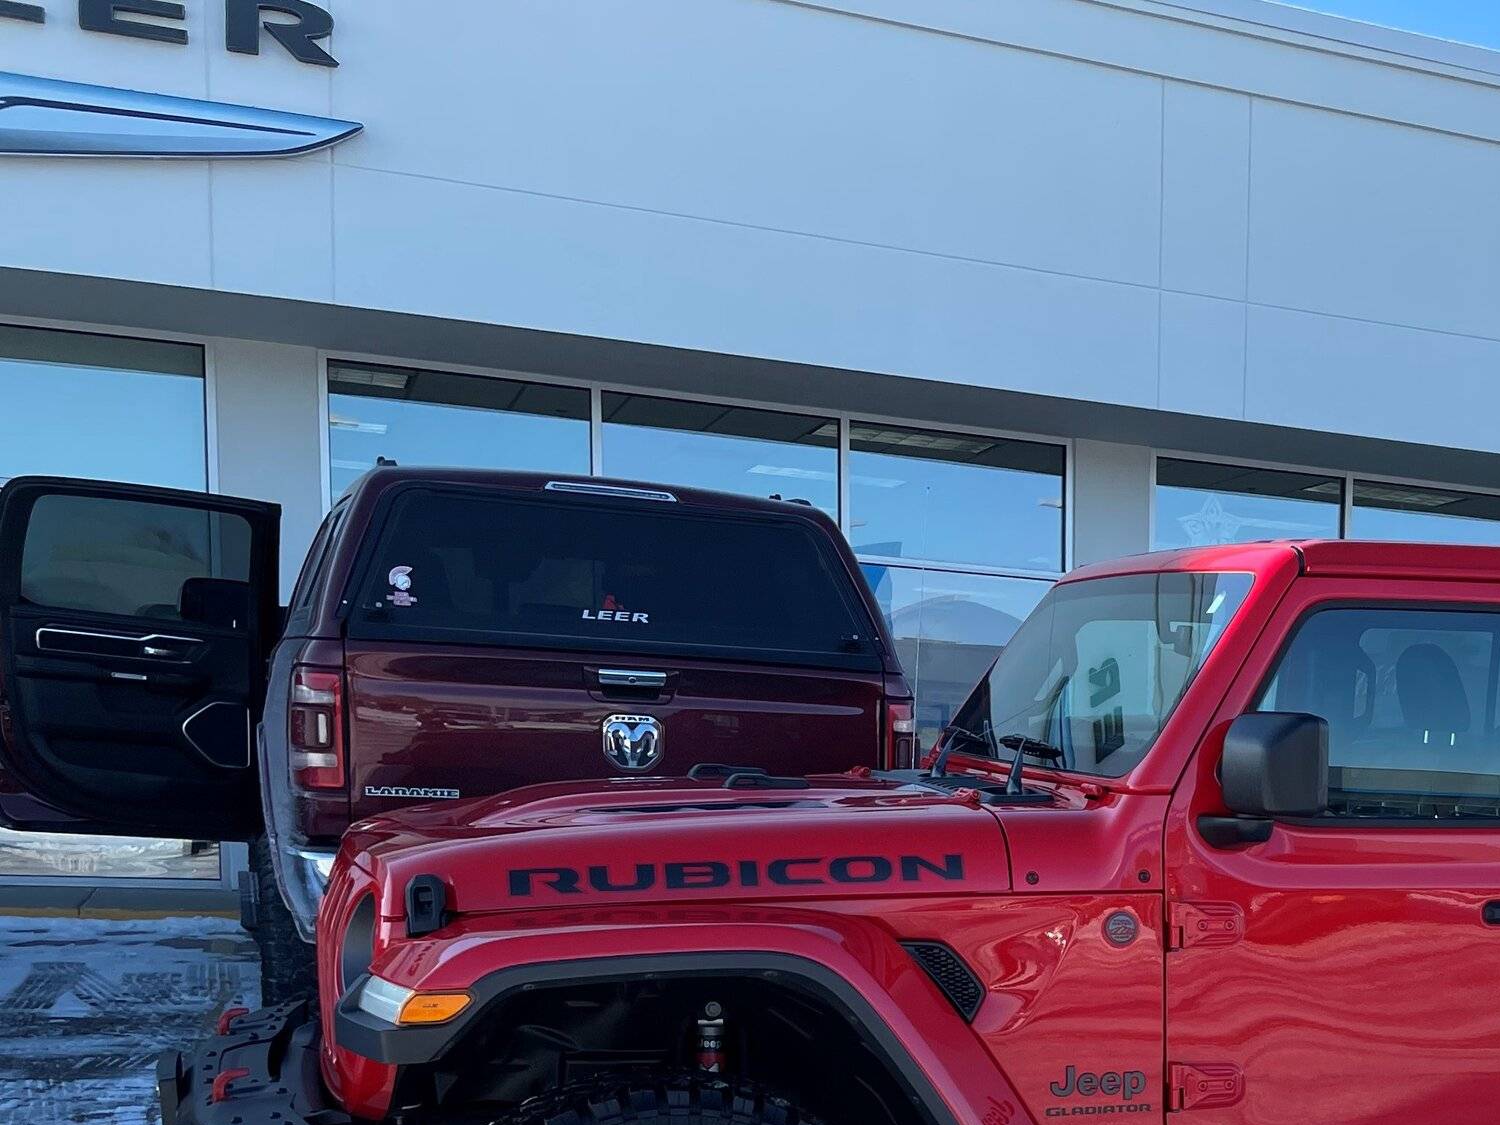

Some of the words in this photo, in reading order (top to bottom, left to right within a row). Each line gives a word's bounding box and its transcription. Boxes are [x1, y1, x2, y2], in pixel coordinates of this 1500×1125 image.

[0, 0, 340, 67] ER
[581, 609, 649, 624] LEER
[365, 785, 460, 800] LARAMIE
[508, 854, 965, 897] RUBICON
[1049, 1064, 1147, 1100] Jeep
[1045, 1103, 1152, 1117] GLADIATOR
